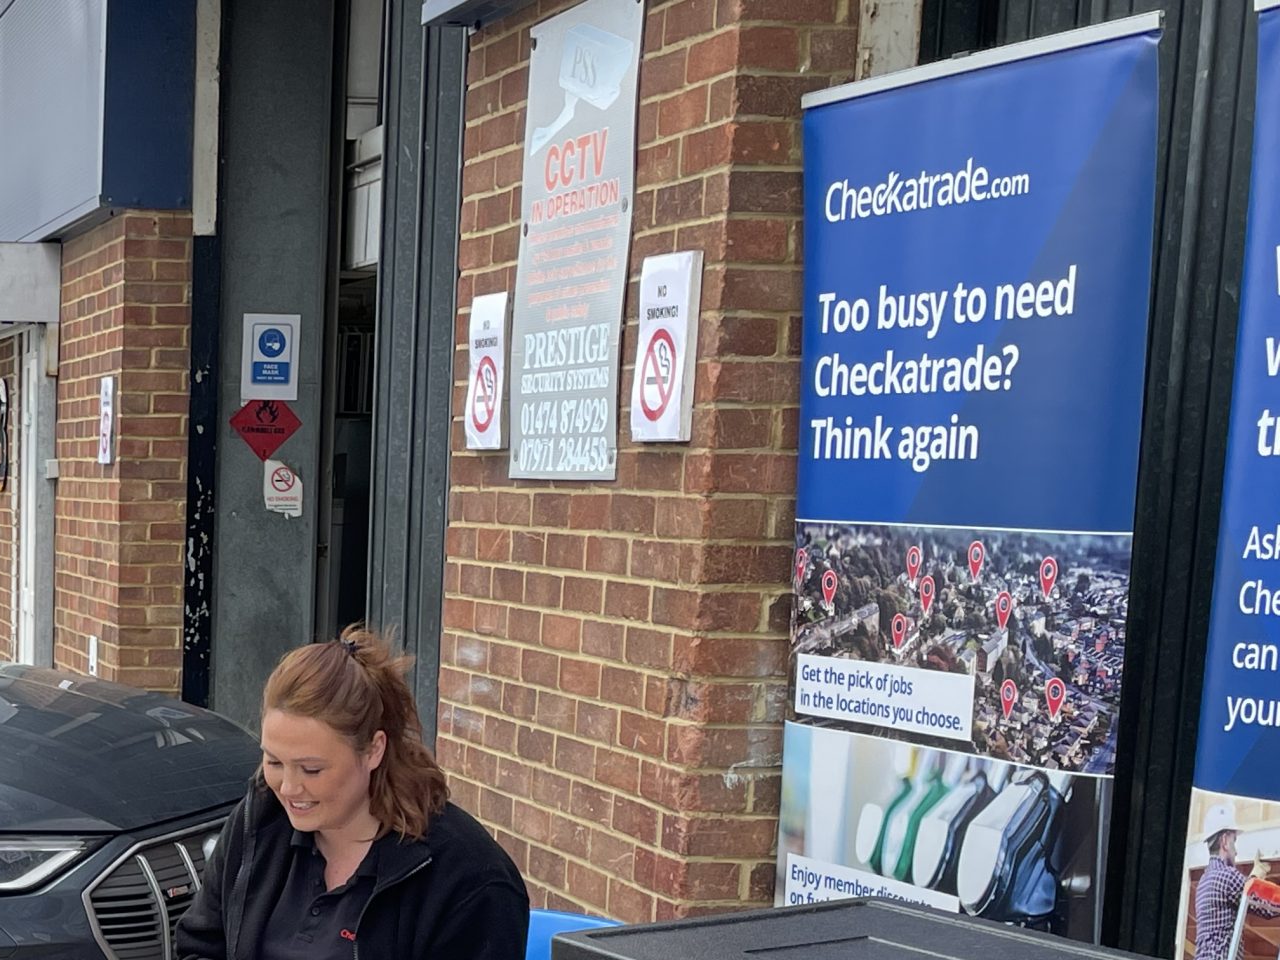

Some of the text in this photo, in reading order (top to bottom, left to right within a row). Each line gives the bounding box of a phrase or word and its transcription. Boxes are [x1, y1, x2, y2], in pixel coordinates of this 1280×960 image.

[545, 127, 609, 192] CCTV
[531, 178, 619, 223] IN OPERATION
[657, 284, 667, 298] NO
[819, 264, 1077, 339] Too busy to need
[523, 322, 611, 370] PRESTIGE
[521, 366, 610, 394] SECURITY SYSTEMS
[814, 344, 1019, 397] Checkatrade?
[811, 413, 980, 473] Think again
[1232, 642, 1278, 671] can
[801, 664, 913, 697] Get the pick of jobs
[800, 688, 964, 731] in the locations you choose.
[790, 891, 804, 905] on
[791, 863, 822, 891] Enjoy
[824, 875, 874, 897] member
